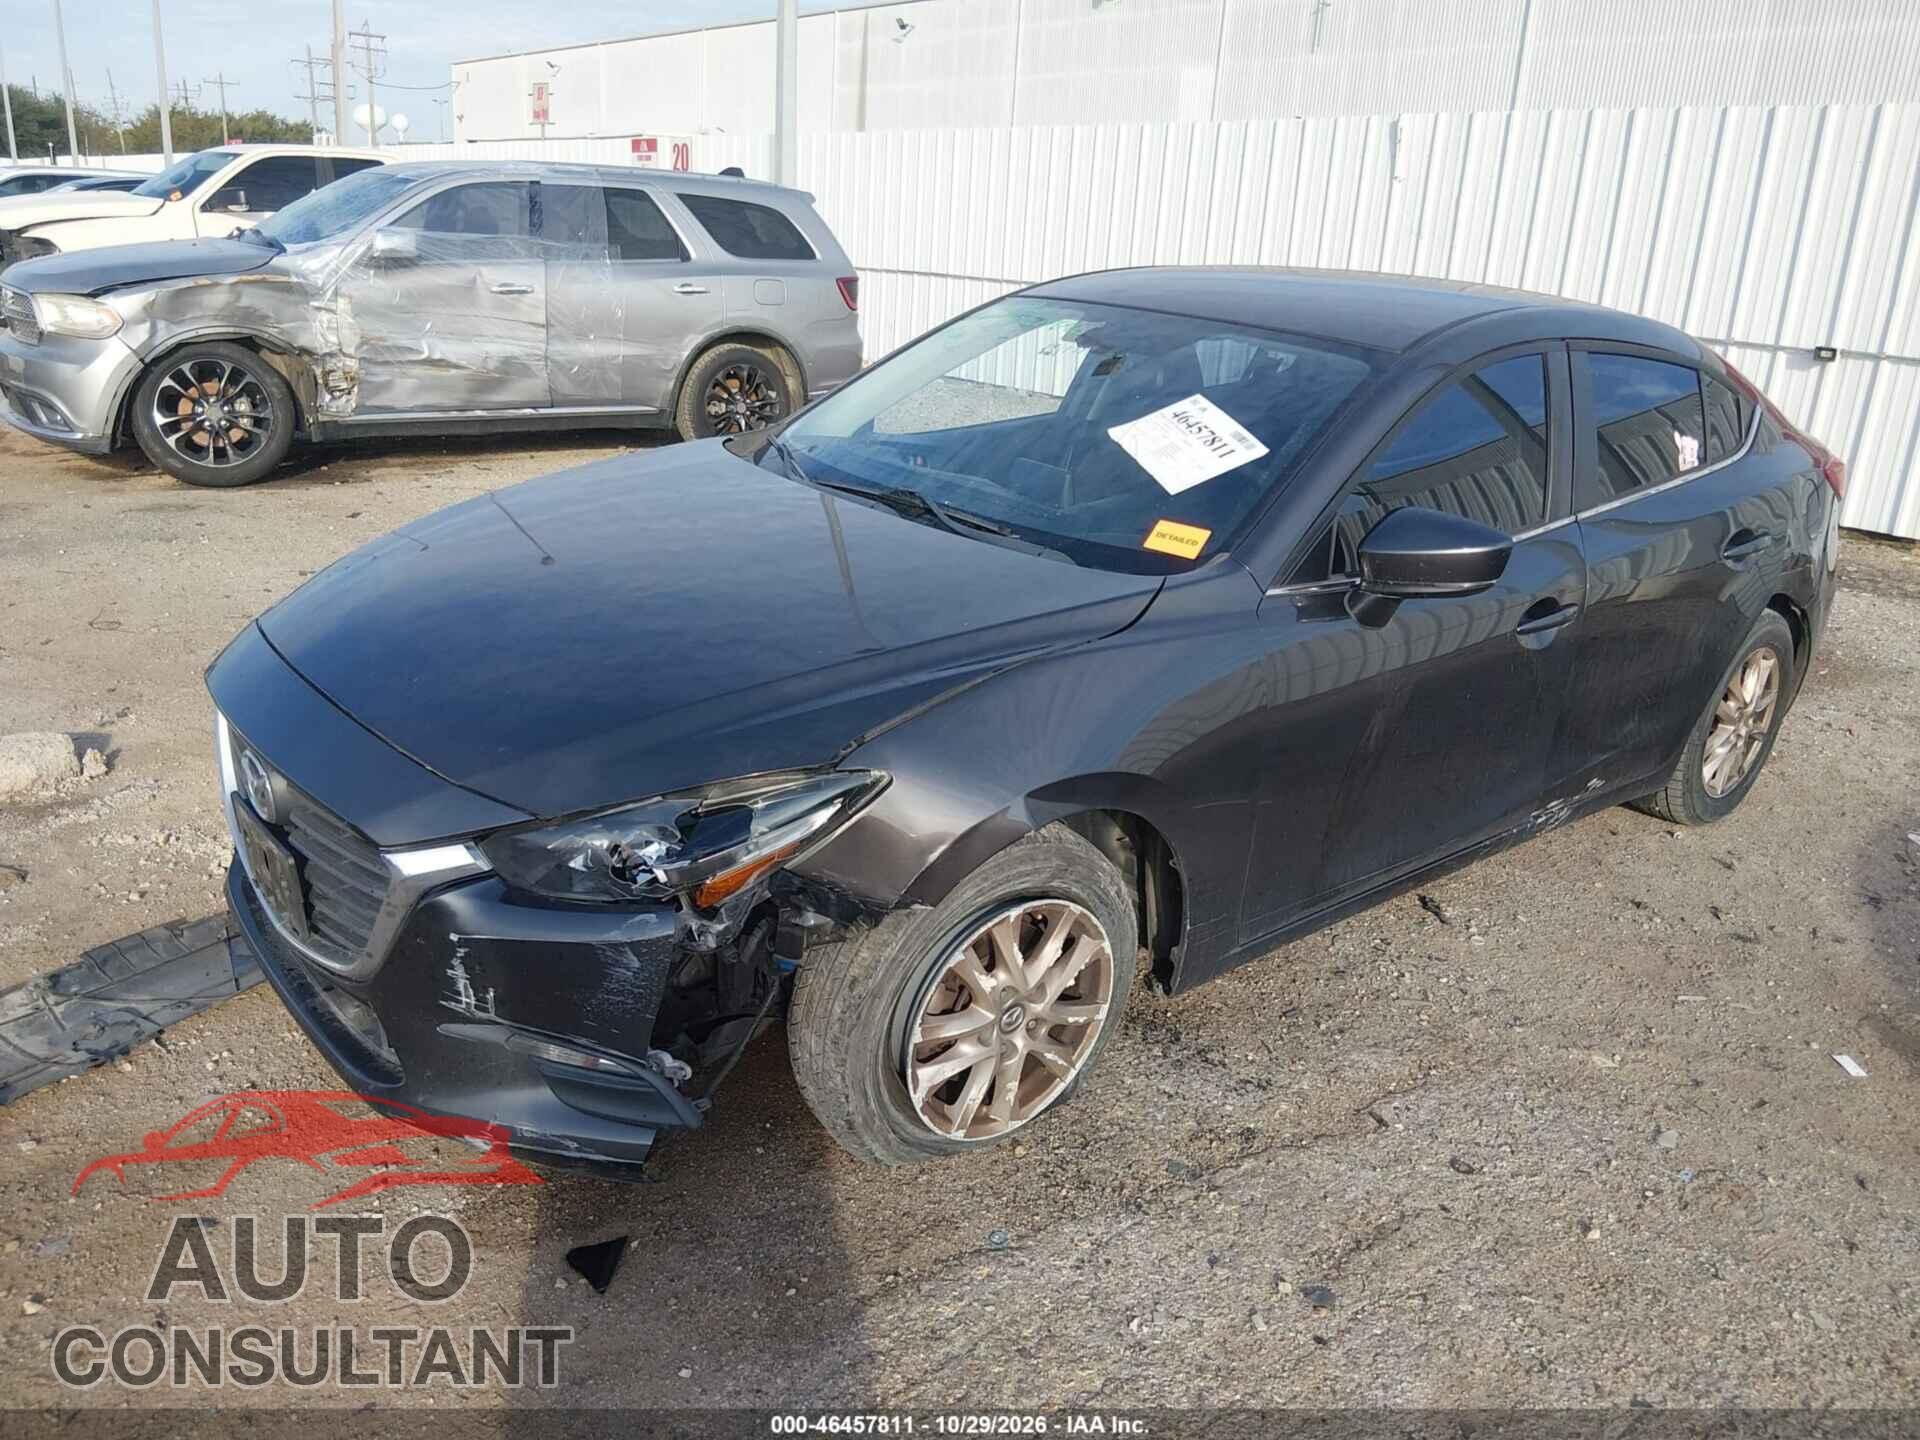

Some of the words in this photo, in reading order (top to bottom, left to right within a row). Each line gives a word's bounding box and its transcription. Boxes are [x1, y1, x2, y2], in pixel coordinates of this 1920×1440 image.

[673, 143, 689, 171] 20
[1172, 410, 1235, 458] 46457811
[1155, 531, 1199, 547] DETAILED
